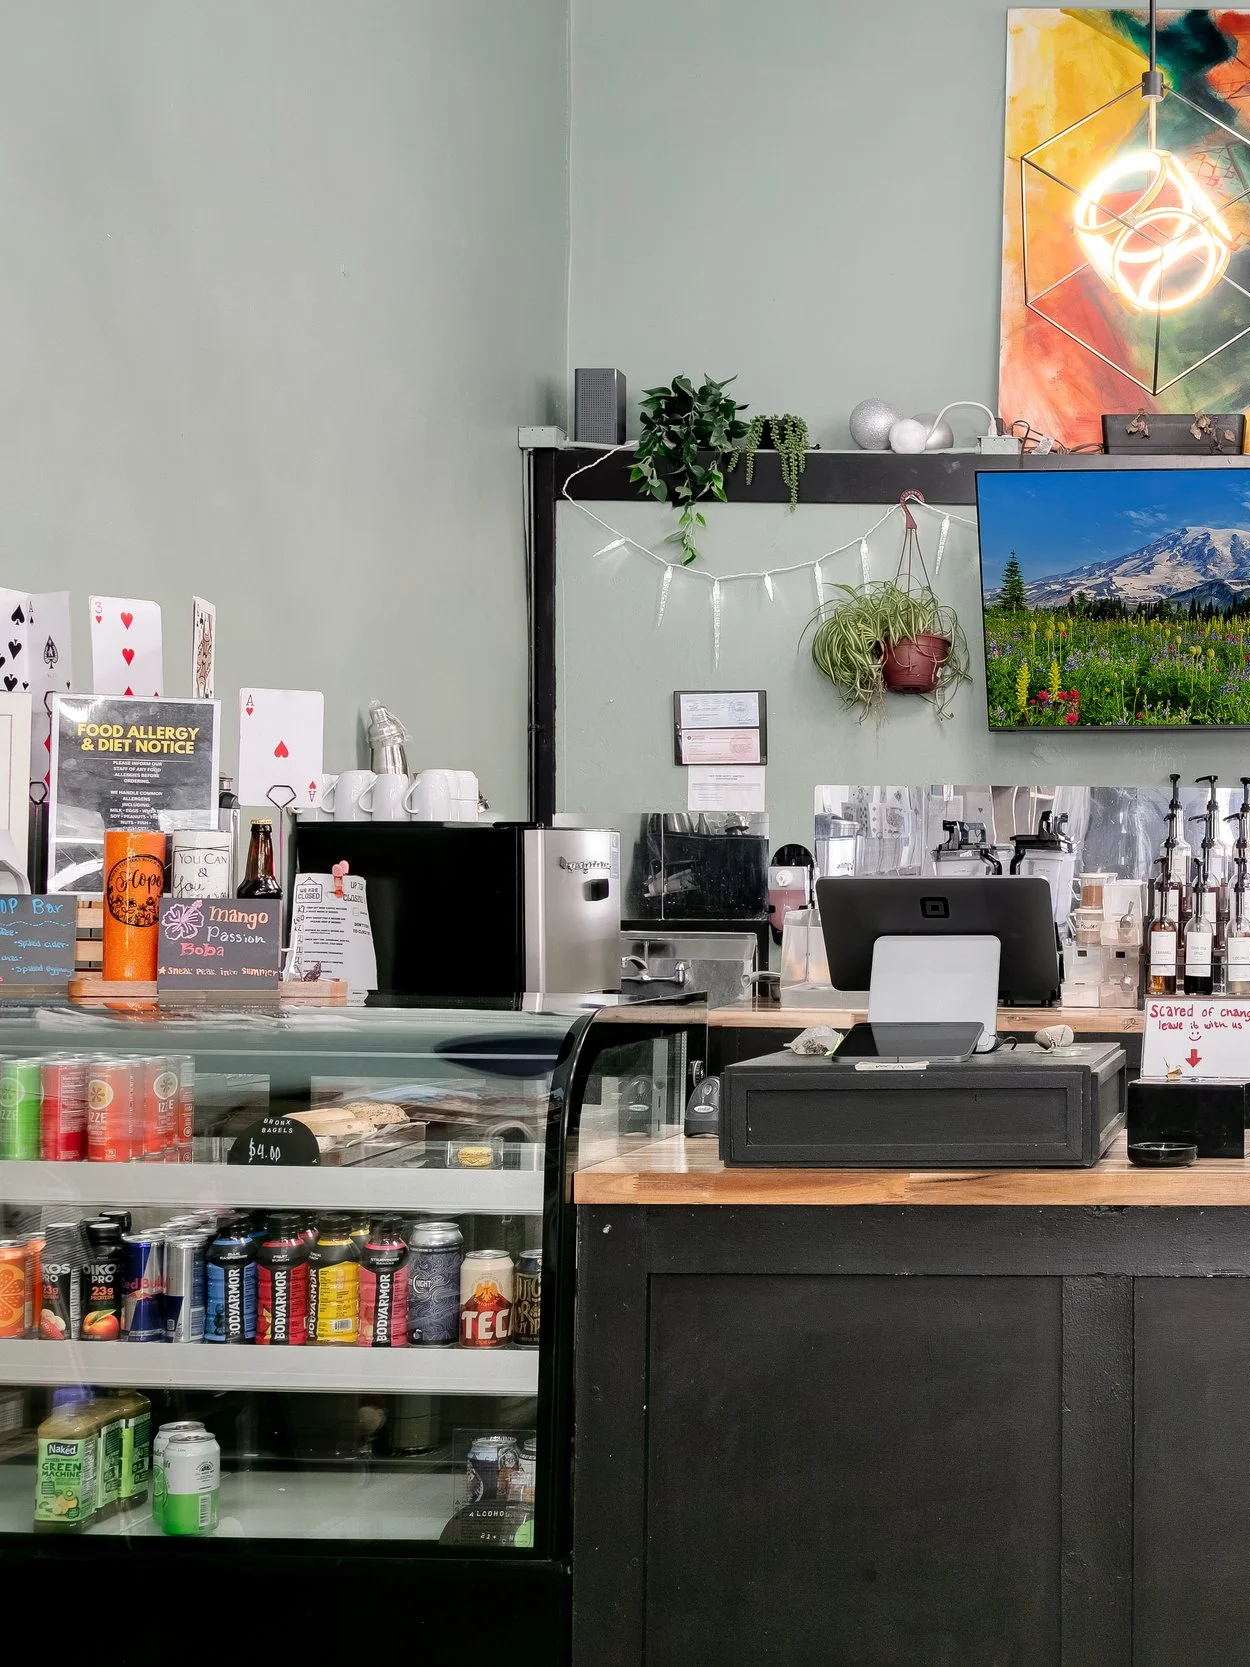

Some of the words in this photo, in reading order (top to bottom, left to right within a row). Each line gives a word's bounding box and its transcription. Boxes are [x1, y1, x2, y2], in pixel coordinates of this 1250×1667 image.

[95, 602, 103, 614] 3
[246, 694, 255, 707] A
[77, 723, 124, 739] FOOD
[126, 725, 200, 741] ALLERGY
[81, 738, 95, 751] &
[98, 738, 132, 753] DIET
[135, 740, 195, 754] NOTICE
[308, 790, 317, 802] A
[204, 852, 228, 865] CAN
[197, 867, 208, 878] &
[31, 898, 64, 914] Bar
[206, 925, 267, 944] Passion
[179, 942, 225, 957] Boba
[1149, 1003, 1194, 1018] Scared
[1201, 1006, 1215, 1017] of
[1158, 1020, 1183, 1030] leave
[1190, 1020, 1200, 1030] it
[1204, 1020, 1228, 1030] with
[1231, 1022, 1243, 1030] us
[158, 1101, 174, 1113] IZZE
[88, 1112, 108, 1123] IZZE
[263, 1117, 291, 1126] BRONX
[248, 1137, 281, 1163] $4.00
[41, 1263, 71, 1275] KOS
[91, 1274, 114, 1284] PRO
[91, 1286, 114, 1296] 23g
[227, 1267, 241, 1336] BODYARMOR
[274, 1270, 287, 1339] BODYARMOR
[376, 1273, 391, 1343] BODYARMOR
[42, 1462, 82, 1471] GREEN
